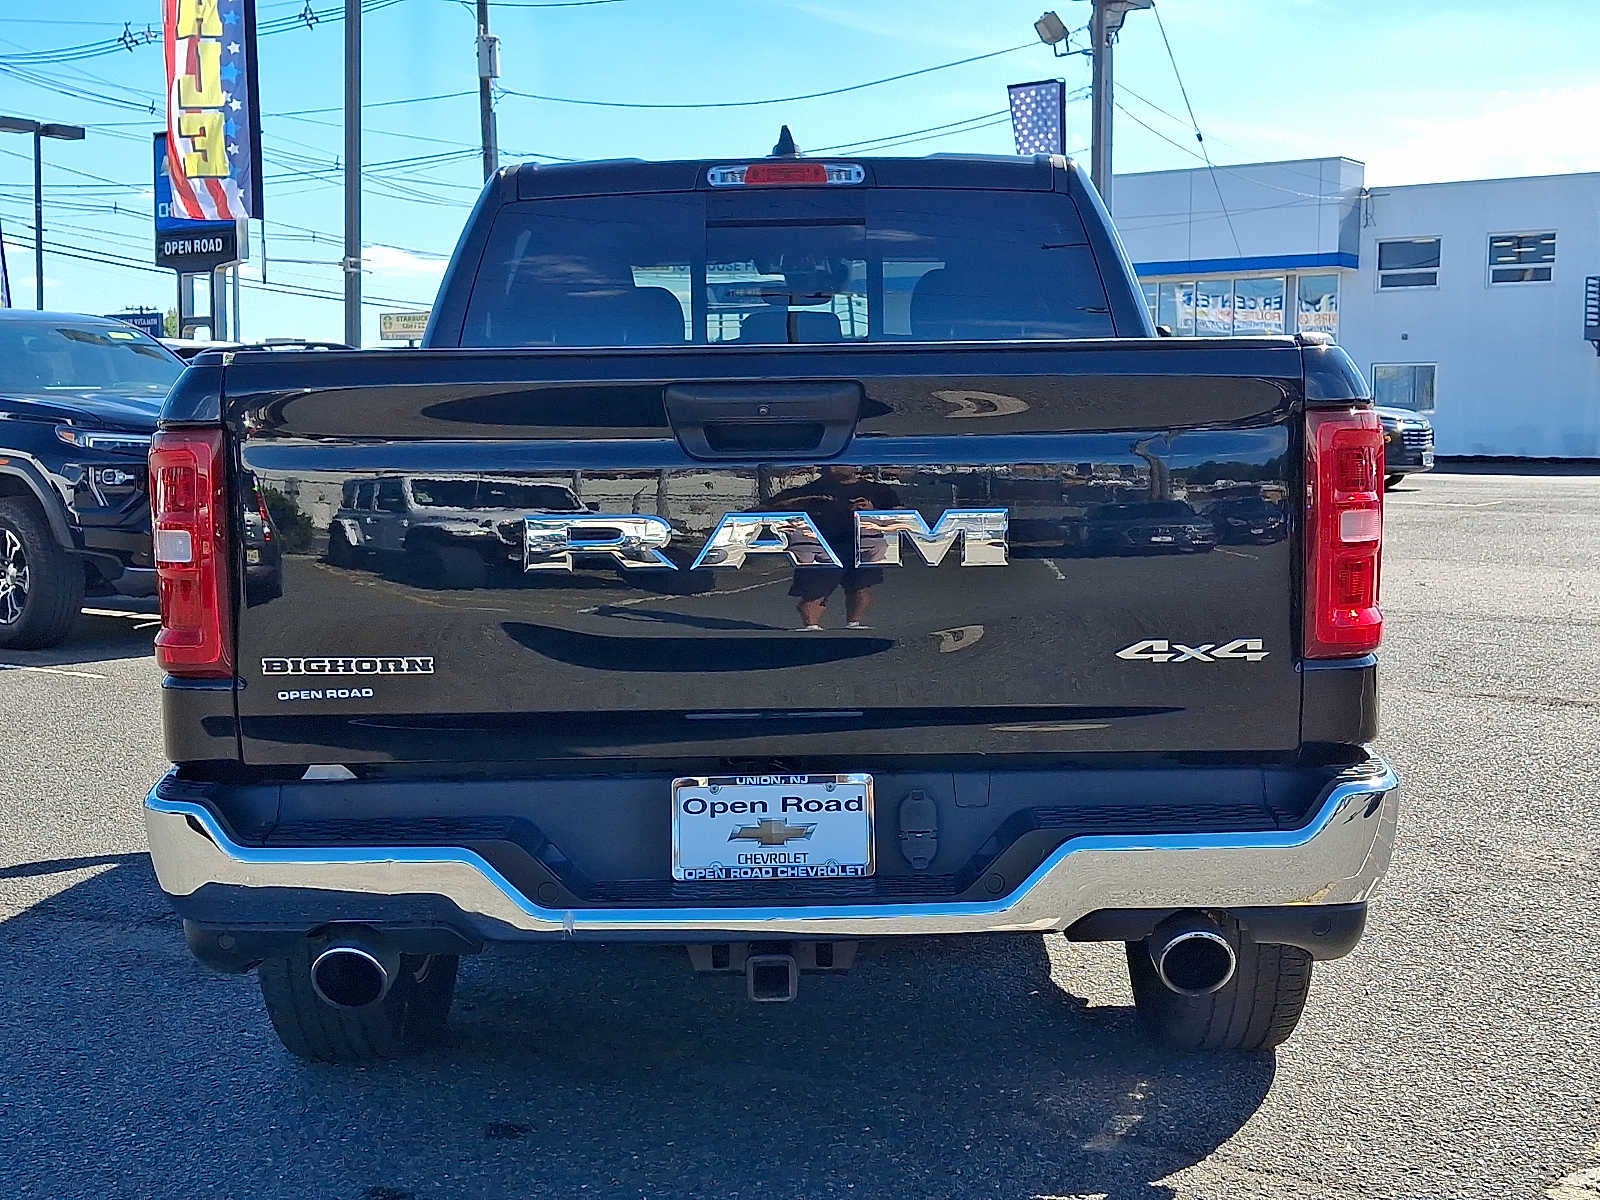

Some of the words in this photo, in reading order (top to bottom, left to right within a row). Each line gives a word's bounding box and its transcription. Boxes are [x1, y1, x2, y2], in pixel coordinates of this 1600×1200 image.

[164, 240, 192, 256] OPEN
[193, 238, 223, 253] ROAD
[396, 314, 429, 322] STARBUCK
[523, 508, 1009, 571] RAM
[1115, 638, 1270, 662] 4x4
[261, 657, 434, 675] BIGHORN
[277, 689, 323, 701] OPEN
[326, 688, 374, 699] ROAD
[736, 776, 784, 785] UNION,
[790, 775, 809, 784] NJ
[682, 797, 768, 818] Open
[781, 795, 863, 813] Road
[737, 852, 808, 865] CHEVROLET
[684, 868, 726, 880] OPEN
[730, 867, 773, 879] ROAD
[777, 865, 865, 878] CHEVROLET
